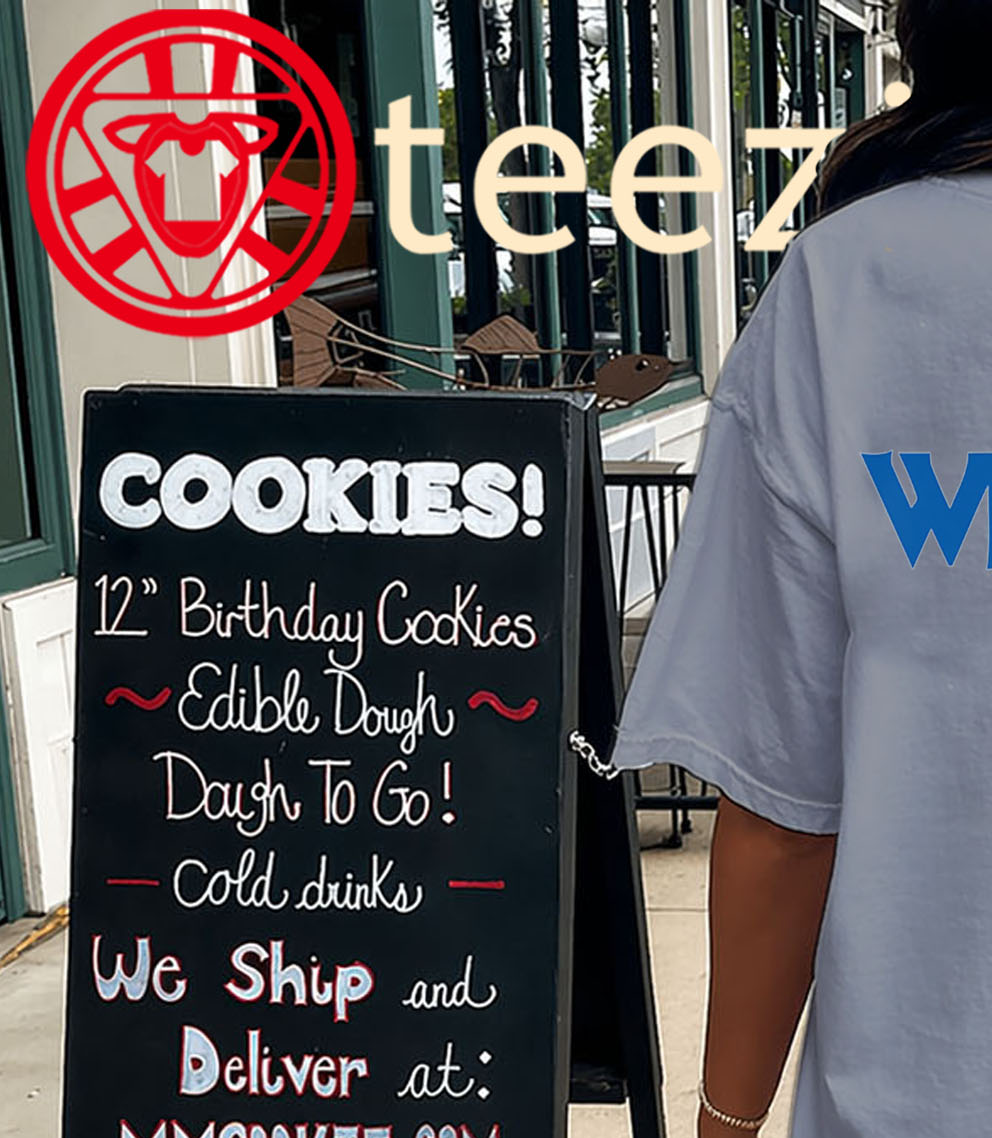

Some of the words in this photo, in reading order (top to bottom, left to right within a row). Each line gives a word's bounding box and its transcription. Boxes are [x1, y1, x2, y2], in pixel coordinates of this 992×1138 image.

[100, 453, 544, 538] COOKIES!
[180, 576, 363, 668] Birthday
[178, 662, 320, 734] Edible
[324, 669, 454, 754] Dough
[153, 751, 301, 836] Dough
[308, 760, 355, 825] To
[173, 848, 289, 909] Cold
[92, 934, 187, 1002] We
[224, 939, 375, 1023] Ship
[402, 955, 497, 1009] and
[178, 1024, 370, 1098] Deliver
[397, 1042, 492, 1099] at:
